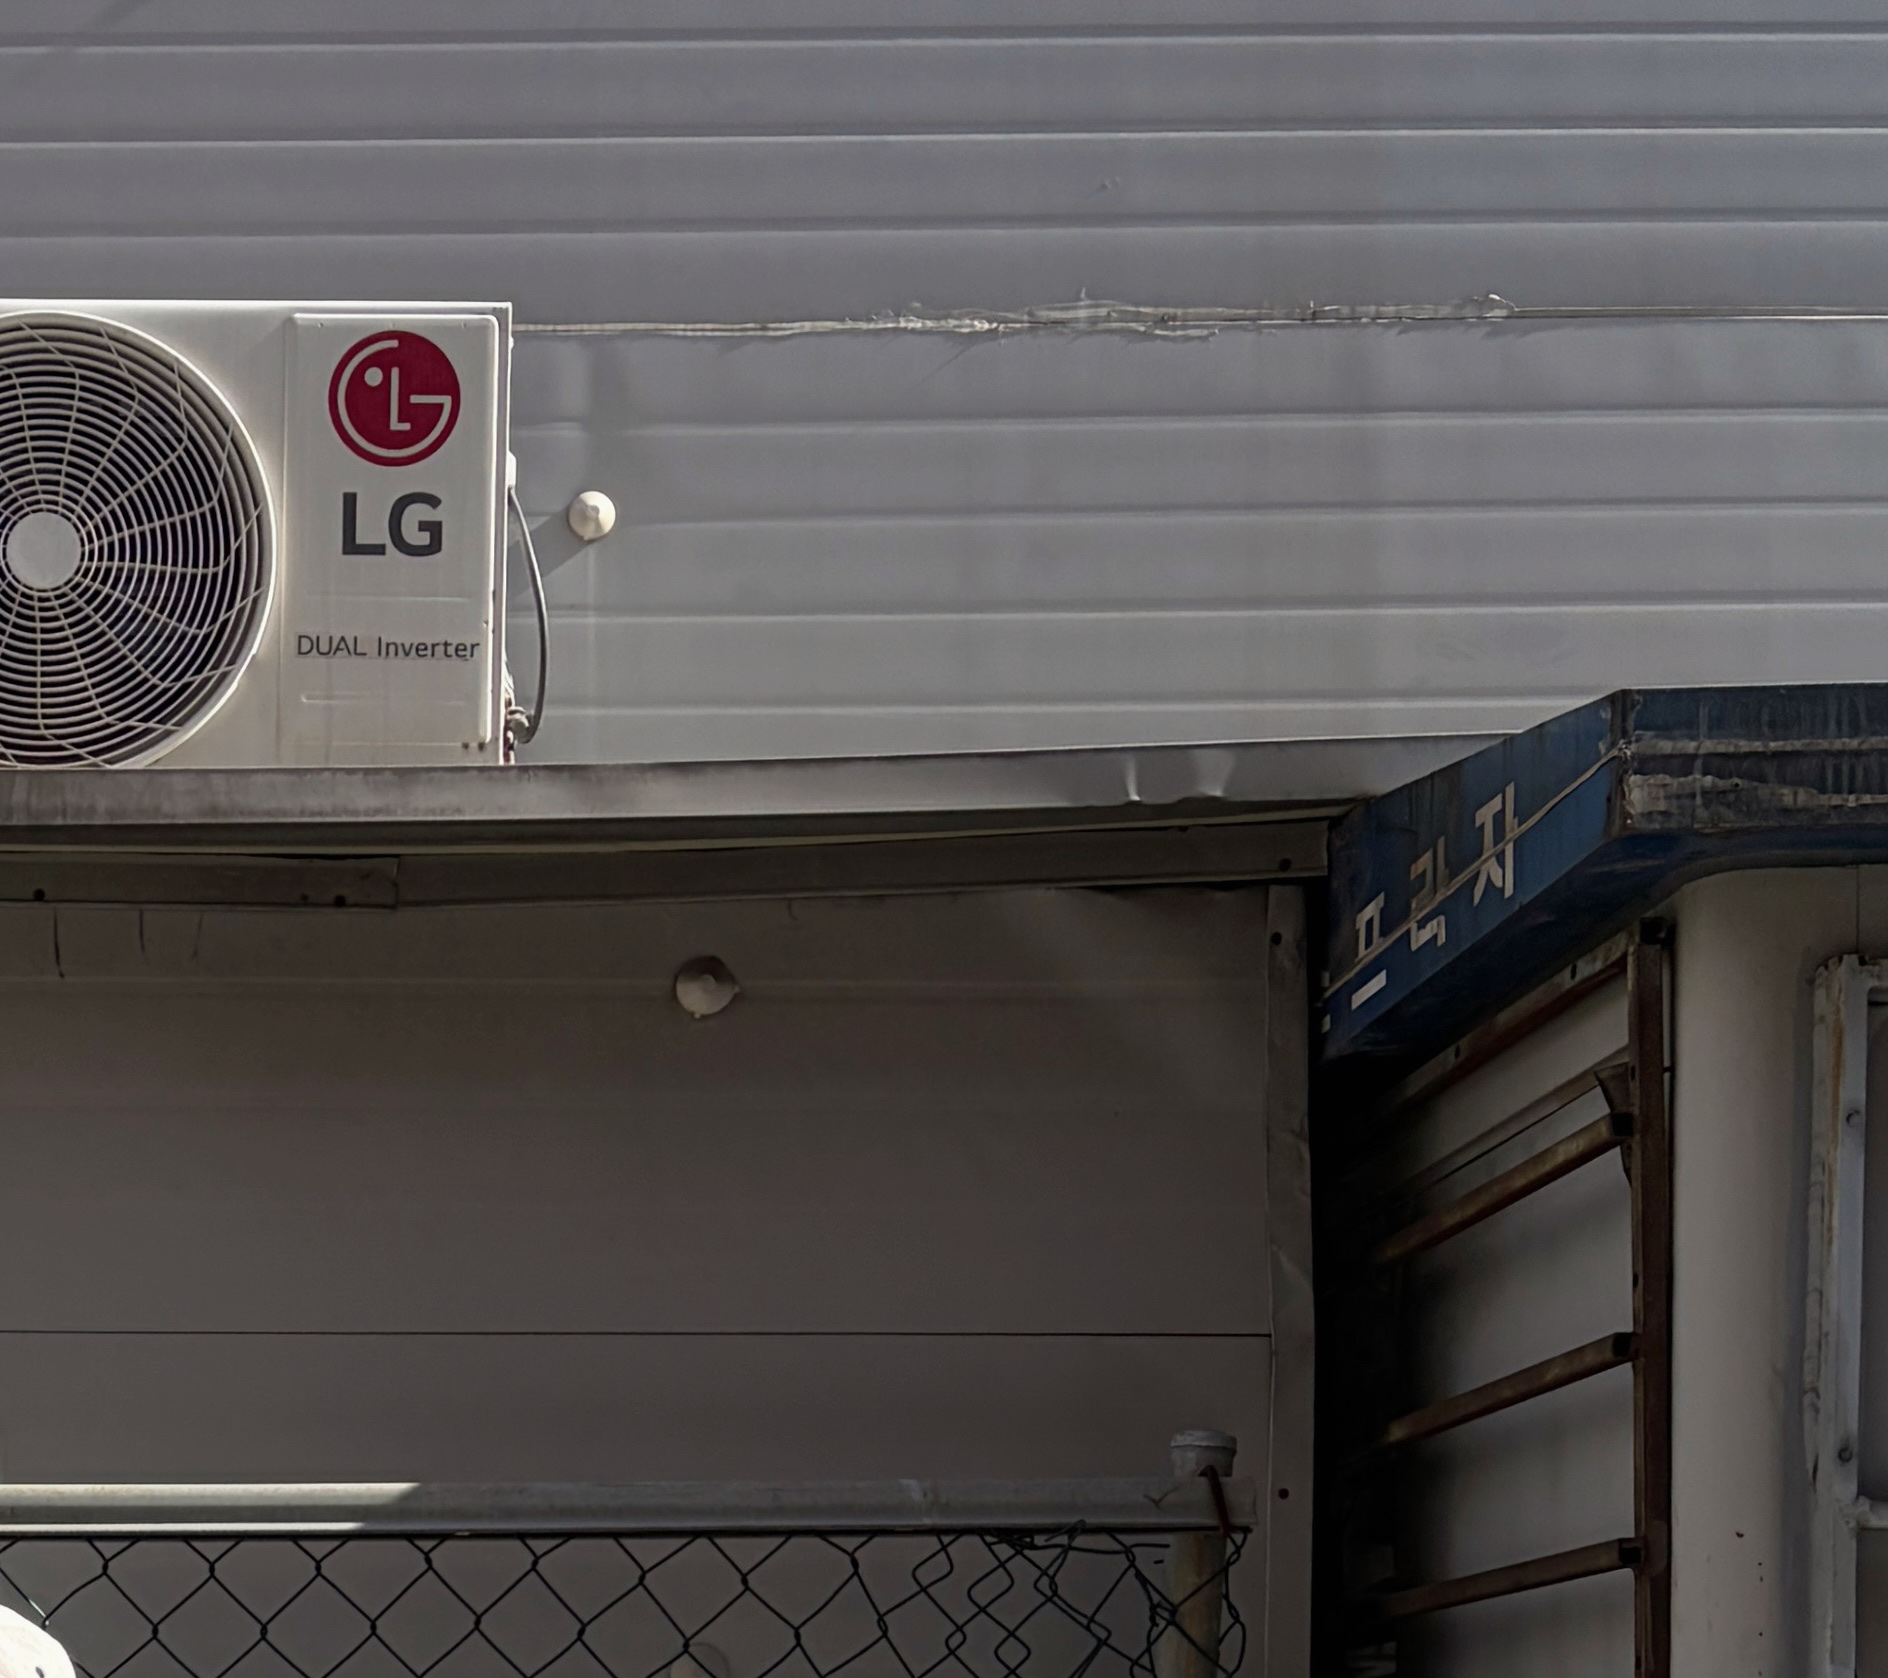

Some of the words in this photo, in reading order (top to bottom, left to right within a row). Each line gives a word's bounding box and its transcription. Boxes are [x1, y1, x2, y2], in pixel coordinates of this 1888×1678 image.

[341, 491, 444, 557] LG
[296, 634, 368, 657] DUAL
[377, 635, 481, 660] Inverter
[1318, 781, 1519, 1034] 프라자
